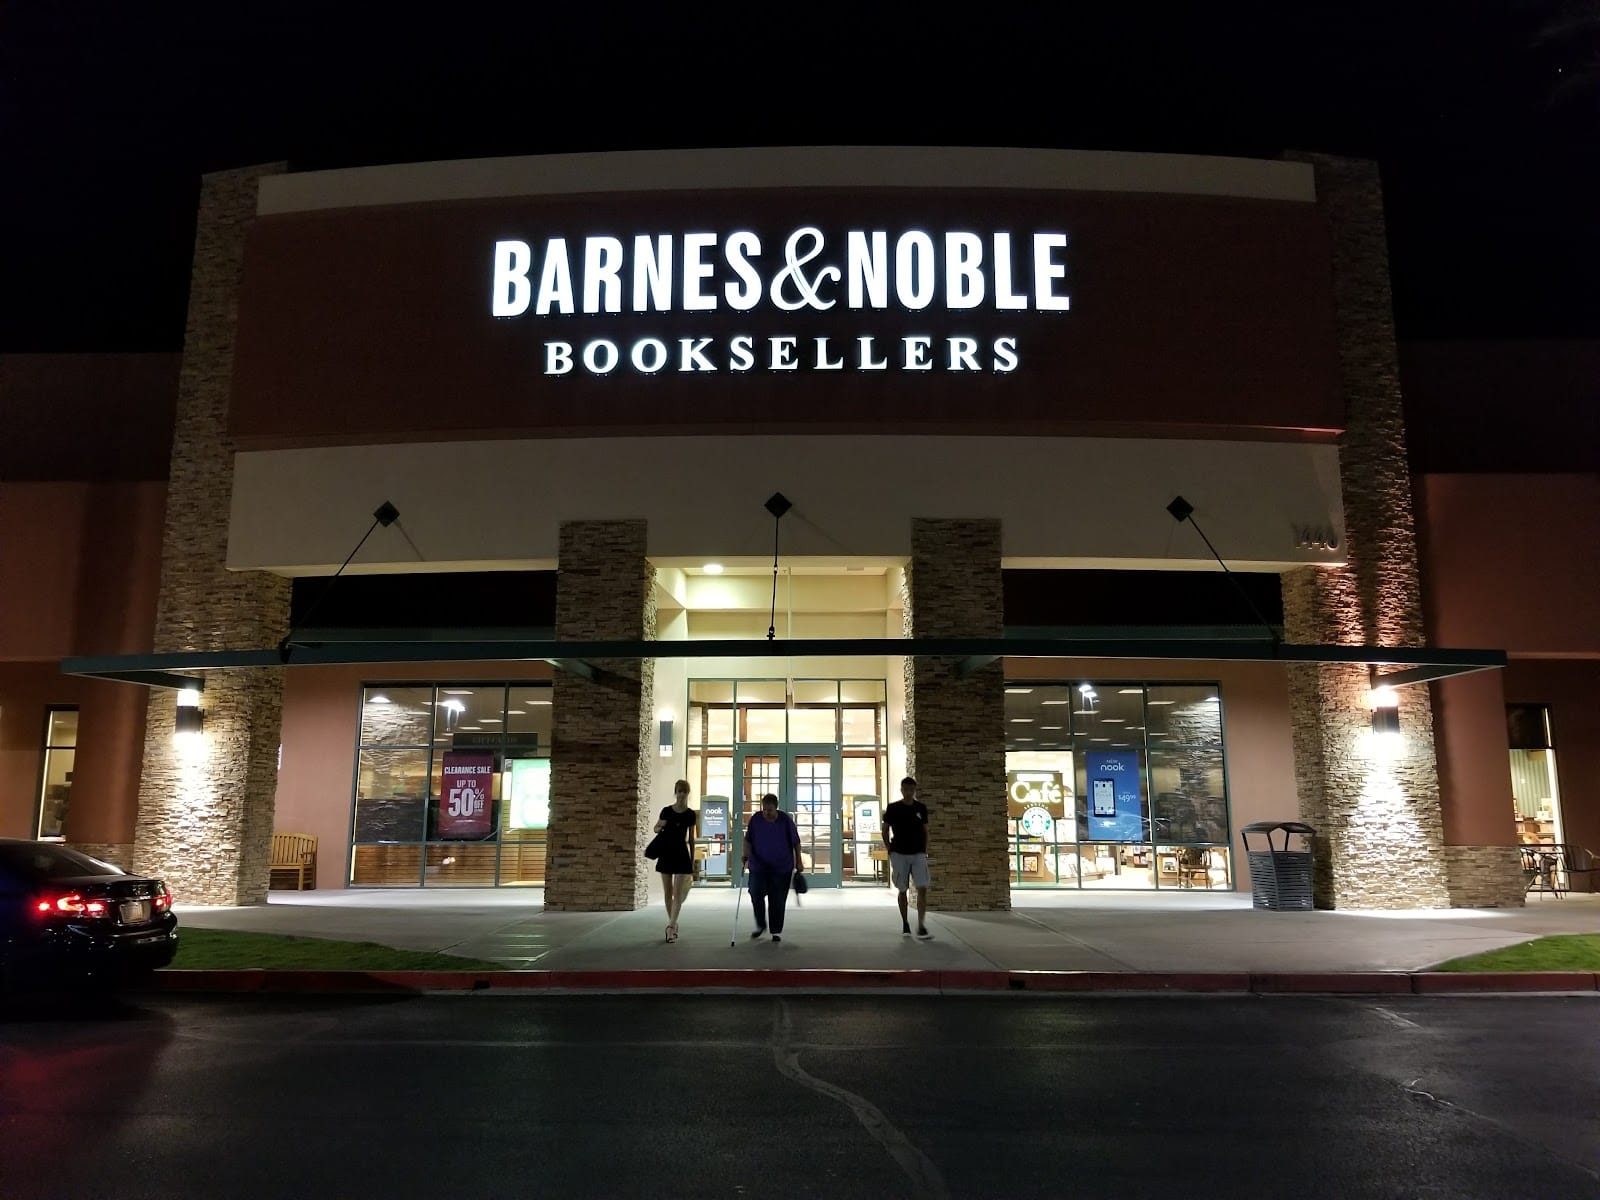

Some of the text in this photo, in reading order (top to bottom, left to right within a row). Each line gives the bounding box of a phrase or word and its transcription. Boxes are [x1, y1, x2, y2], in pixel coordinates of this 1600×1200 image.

[543, 336, 1020, 376] BOOKSELLERS
[444, 766, 491, 775] CLEARANCE SALE
[1100, 763, 1125, 771] nook
[456, 780, 477, 788] UP TO
[1010, 781, 1062, 804] Café
[474, 800, 484, 809] OFF
[705, 807, 723, 815] nook
